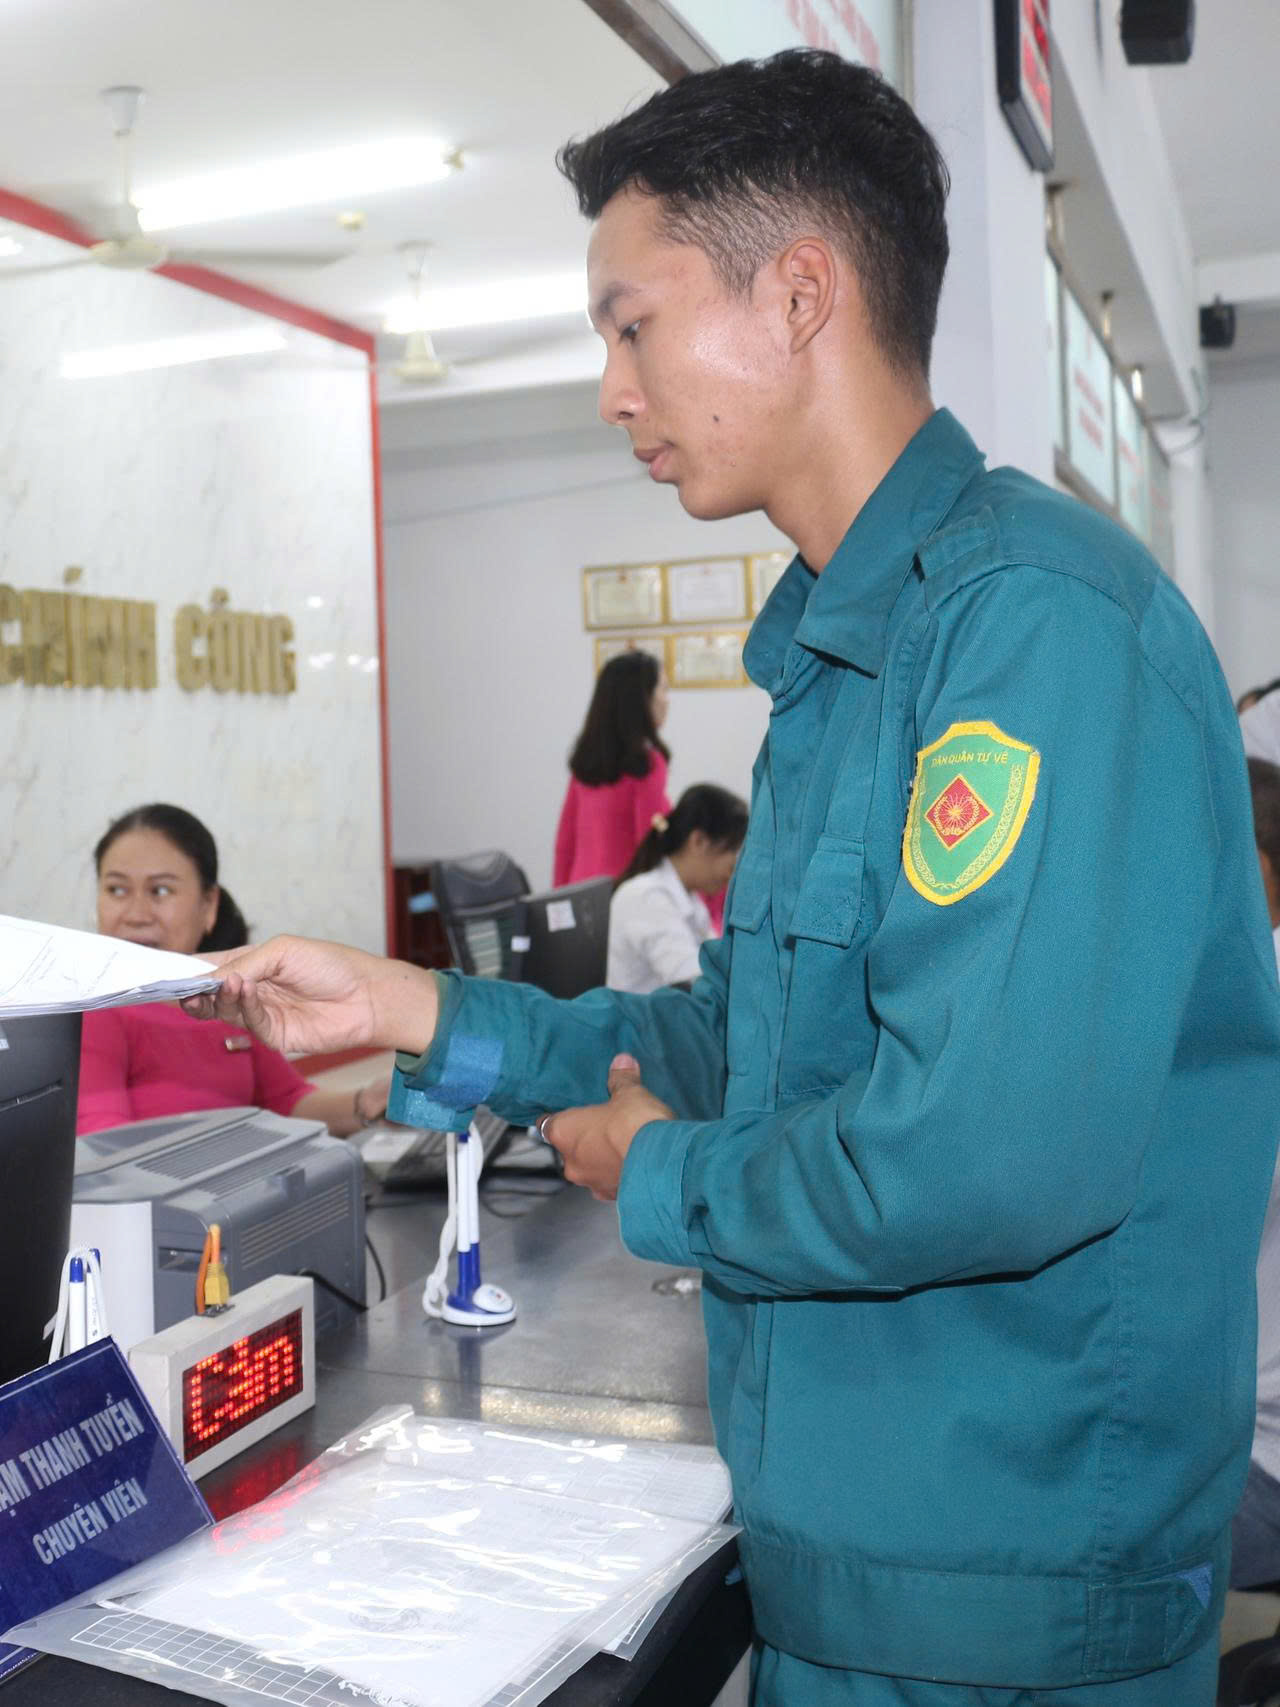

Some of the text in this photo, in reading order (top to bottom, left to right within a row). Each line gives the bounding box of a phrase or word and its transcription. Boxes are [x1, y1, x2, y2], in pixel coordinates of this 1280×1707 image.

[173, 587, 297, 695] CÔNG
[948, 749, 975, 764] QUÂN
[19, 1427, 92, 1490] THANH
[32, 1478, 148, 1565] CHUYÊN VIÊN
